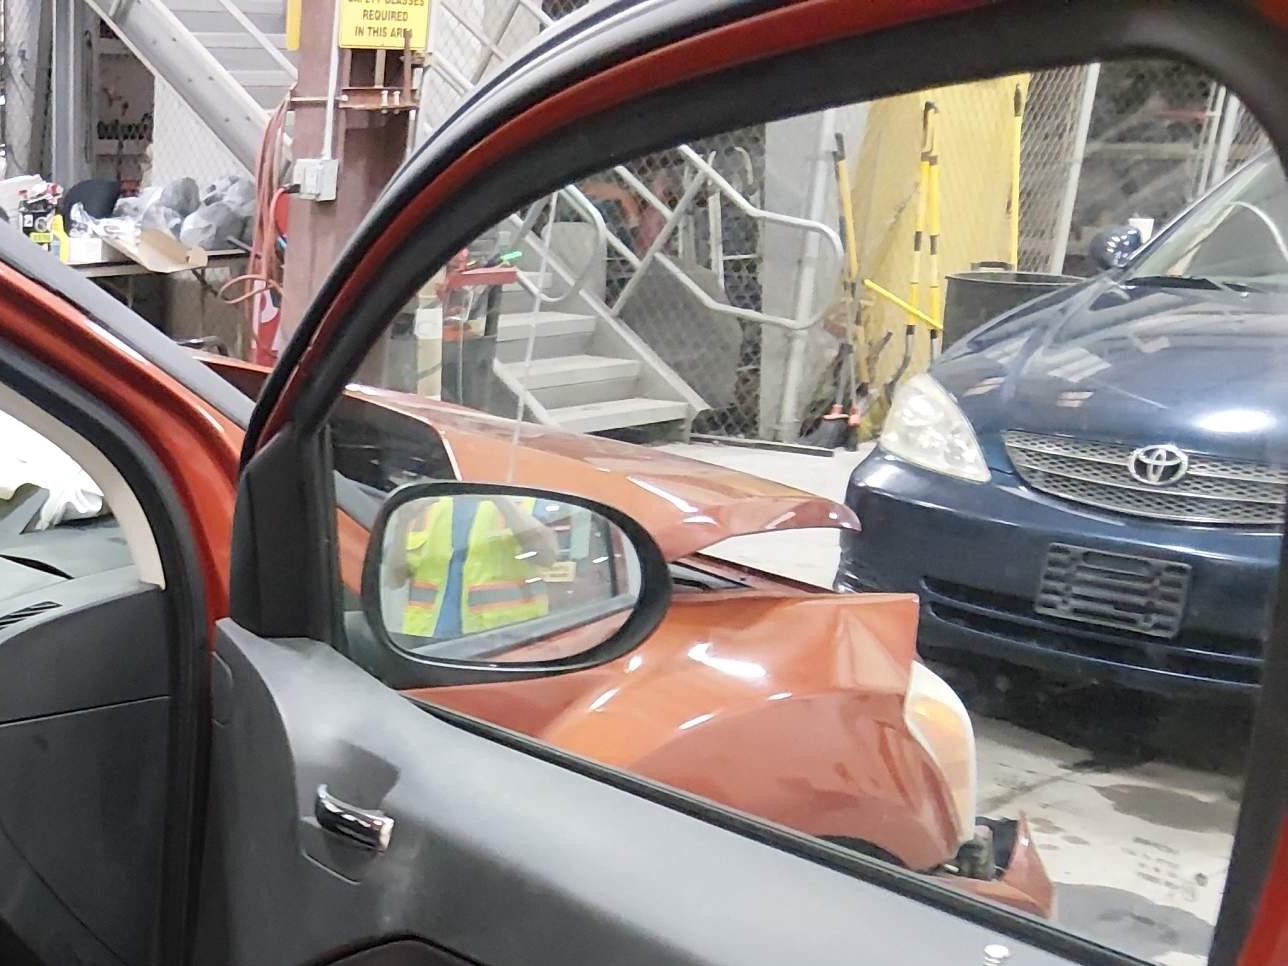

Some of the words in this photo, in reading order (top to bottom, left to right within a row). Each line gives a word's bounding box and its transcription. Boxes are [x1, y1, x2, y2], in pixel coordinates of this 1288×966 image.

[363, 9, 409, 21] REQUIRED
[355, 26, 364, 37] IN
[367, 26, 387, 38] THIS
